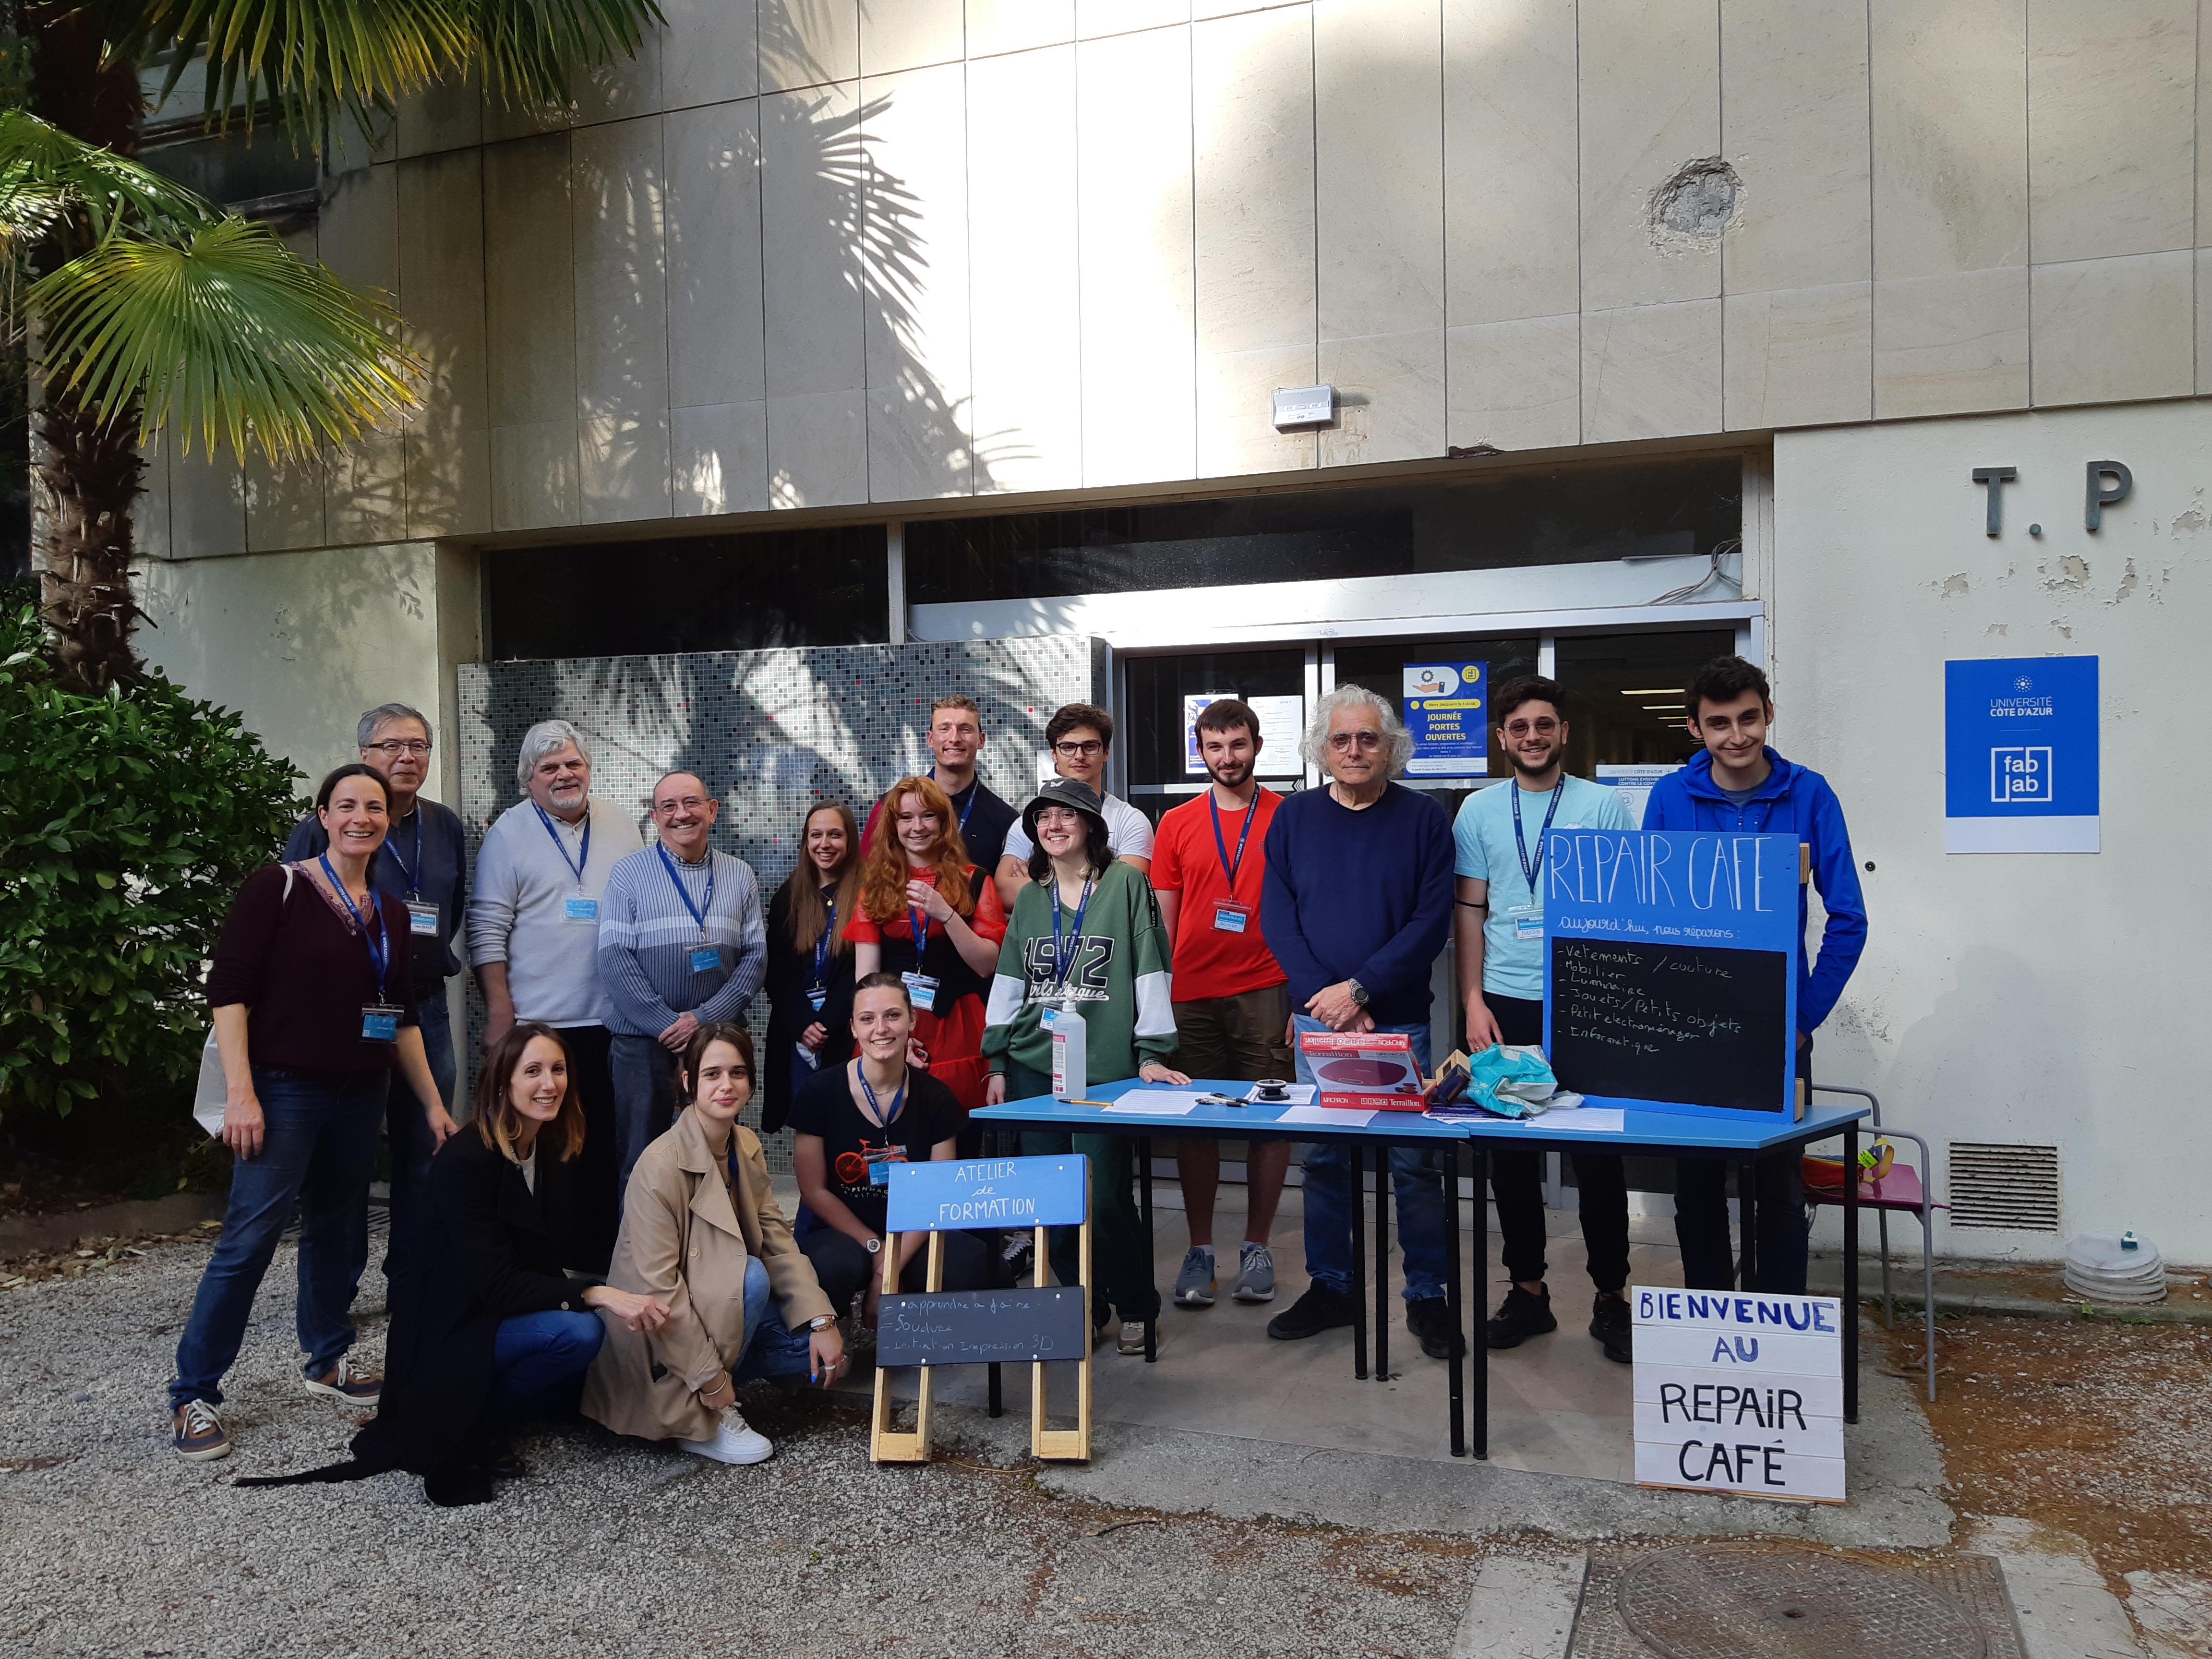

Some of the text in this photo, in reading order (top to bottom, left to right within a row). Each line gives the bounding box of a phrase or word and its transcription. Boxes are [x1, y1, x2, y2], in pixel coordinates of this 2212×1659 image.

[2086, 460, 2132, 530] P
[1990, 696, 2053, 708] UNIVERSITÉ
[1427, 711, 1462, 722] JOURNÉE
[1990, 708, 2053, 717] CÔTE D'AZUR
[1429, 723, 1460, 731] PORTES
[2004, 755, 2038, 773] fab
[1551, 834, 1773, 912] REPAIR CAFE
[1652, 924, 1680, 936] nous
[1683, 925, 1733, 939] réparons
[1024, 936, 1115, 988] 1972
[1565, 960, 1626, 979] Mobilier
[1571, 1004, 1602, 1020] Petit
[954, 1161, 1017, 1183] ATELIER
[840, 1183, 889, 1194] COPENHAG
[971, 1186, 996, 1198] de
[939, 1197, 1035, 1222] FORMATION
[1640, 1292, 1835, 1333] BIENVENUE
[895, 1314, 953, 1334] Soudure
[960, 1341, 1024, 1354] Impression
[1032, 1334, 1054, 1351] 3D
[1711, 1336, 1758, 1363] AU
[1679, 1439, 1785, 1486] CAFÉ
